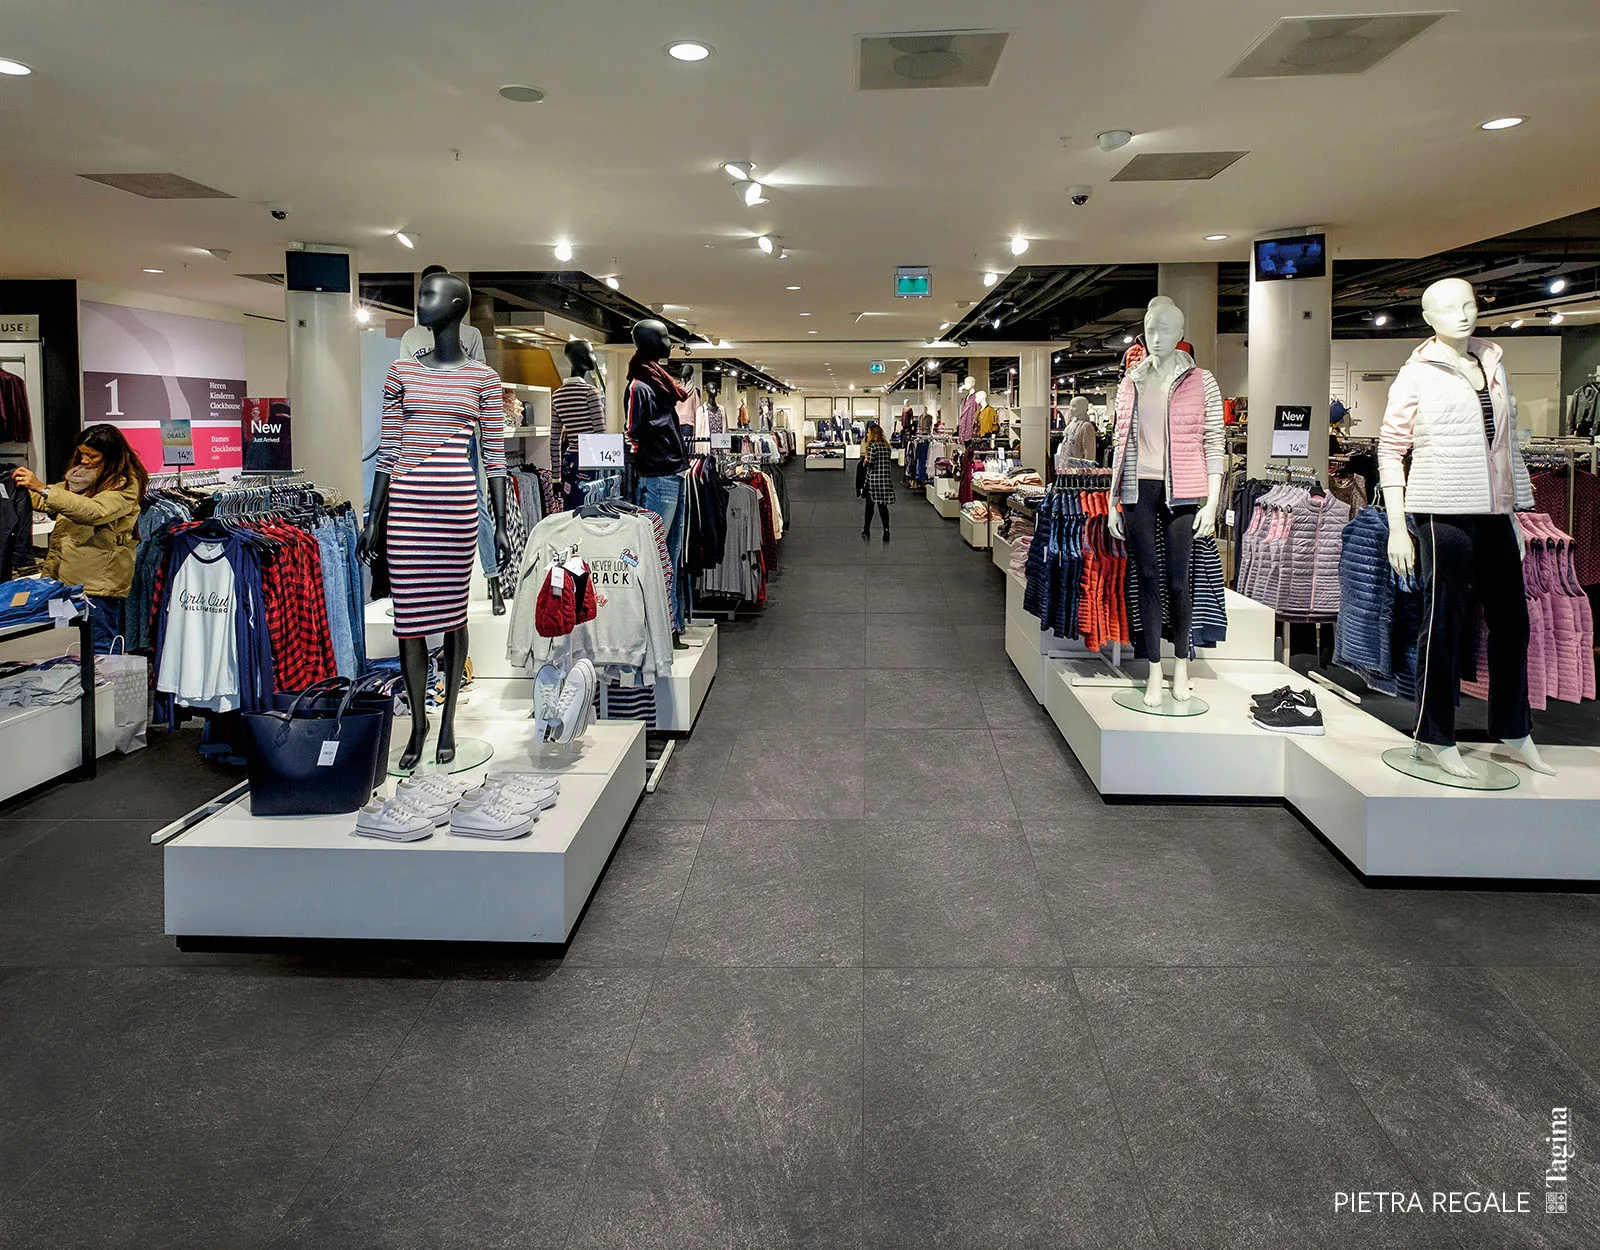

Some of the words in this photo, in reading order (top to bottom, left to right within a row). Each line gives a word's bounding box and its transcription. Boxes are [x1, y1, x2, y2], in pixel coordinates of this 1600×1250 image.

[209, 382, 227, 390] Heren
[104, 378, 125, 416] 1
[209, 391, 236, 400] Kinderen
[209, 402, 241, 410] Clockhouse
[1281, 410, 1305, 421] New
[250, 419, 282, 434] New
[210, 435, 230, 443] Dames
[210, 445, 242, 453] Clockhouse
[599, 450, 621, 463] 14,90
[591, 560, 612, 572] NEVER
[613, 560, 630, 572] LOOK
[592, 572, 630, 585] BACK
